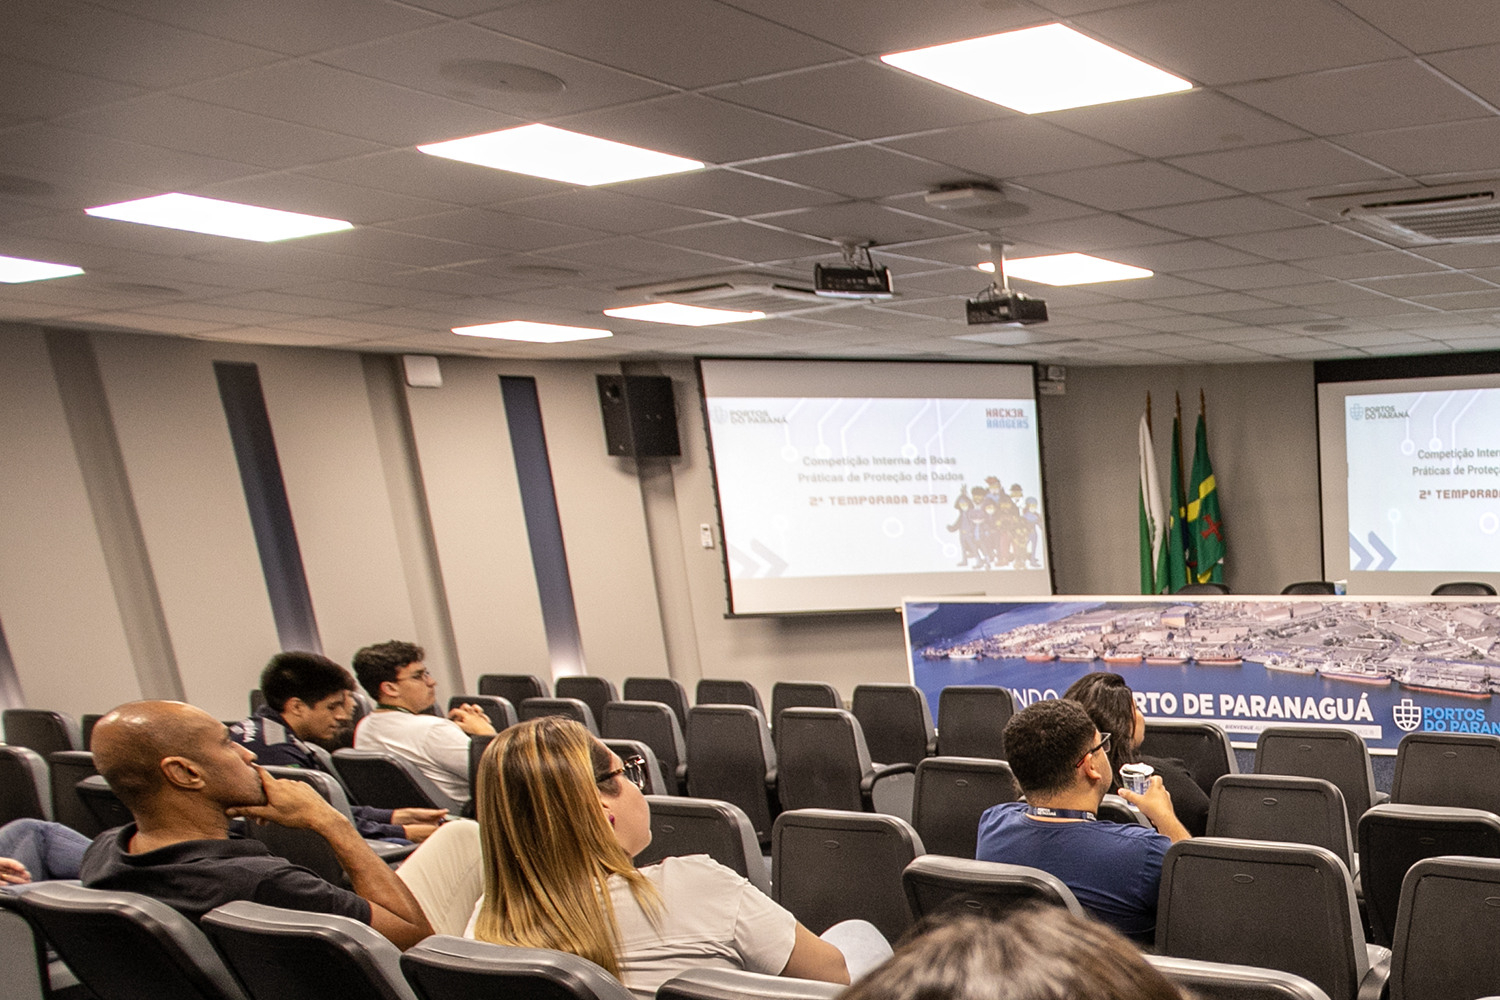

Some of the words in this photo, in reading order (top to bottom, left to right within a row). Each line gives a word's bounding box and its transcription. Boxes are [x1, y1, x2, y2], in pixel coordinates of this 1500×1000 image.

[1364, 405, 1395, 413] PORTOS
[1364, 412, 1376, 420] DO
[1377, 409, 1410, 419] PARANÁ
[802, 456, 869, 467] Competição
[872, 455, 911, 465] Interna
[913, 455, 926, 465] de
[930, 455, 957, 465] Boas
[1417, 449, 1475, 461] Competição
[1412, 465, 1451, 476] Práticas
[1453, 465, 1465, 475] de
[798, 473, 844, 483] Práticas
[847, 472, 861, 482] de
[863, 472, 912, 483] Proteção
[915, 471, 928, 481] de
[931, 471, 964, 481] Dados
[828, 494, 909, 506] TEMPORADA
[912, 494, 948, 504] 2023
[1131, 691, 1177, 716] RTO
[1183, 693, 1215, 716] DE
[1219, 692, 1374, 721] PARANAGUÁ
[1423, 706, 1486, 722] PORTOS
[1424, 720, 1447, 732] DO
